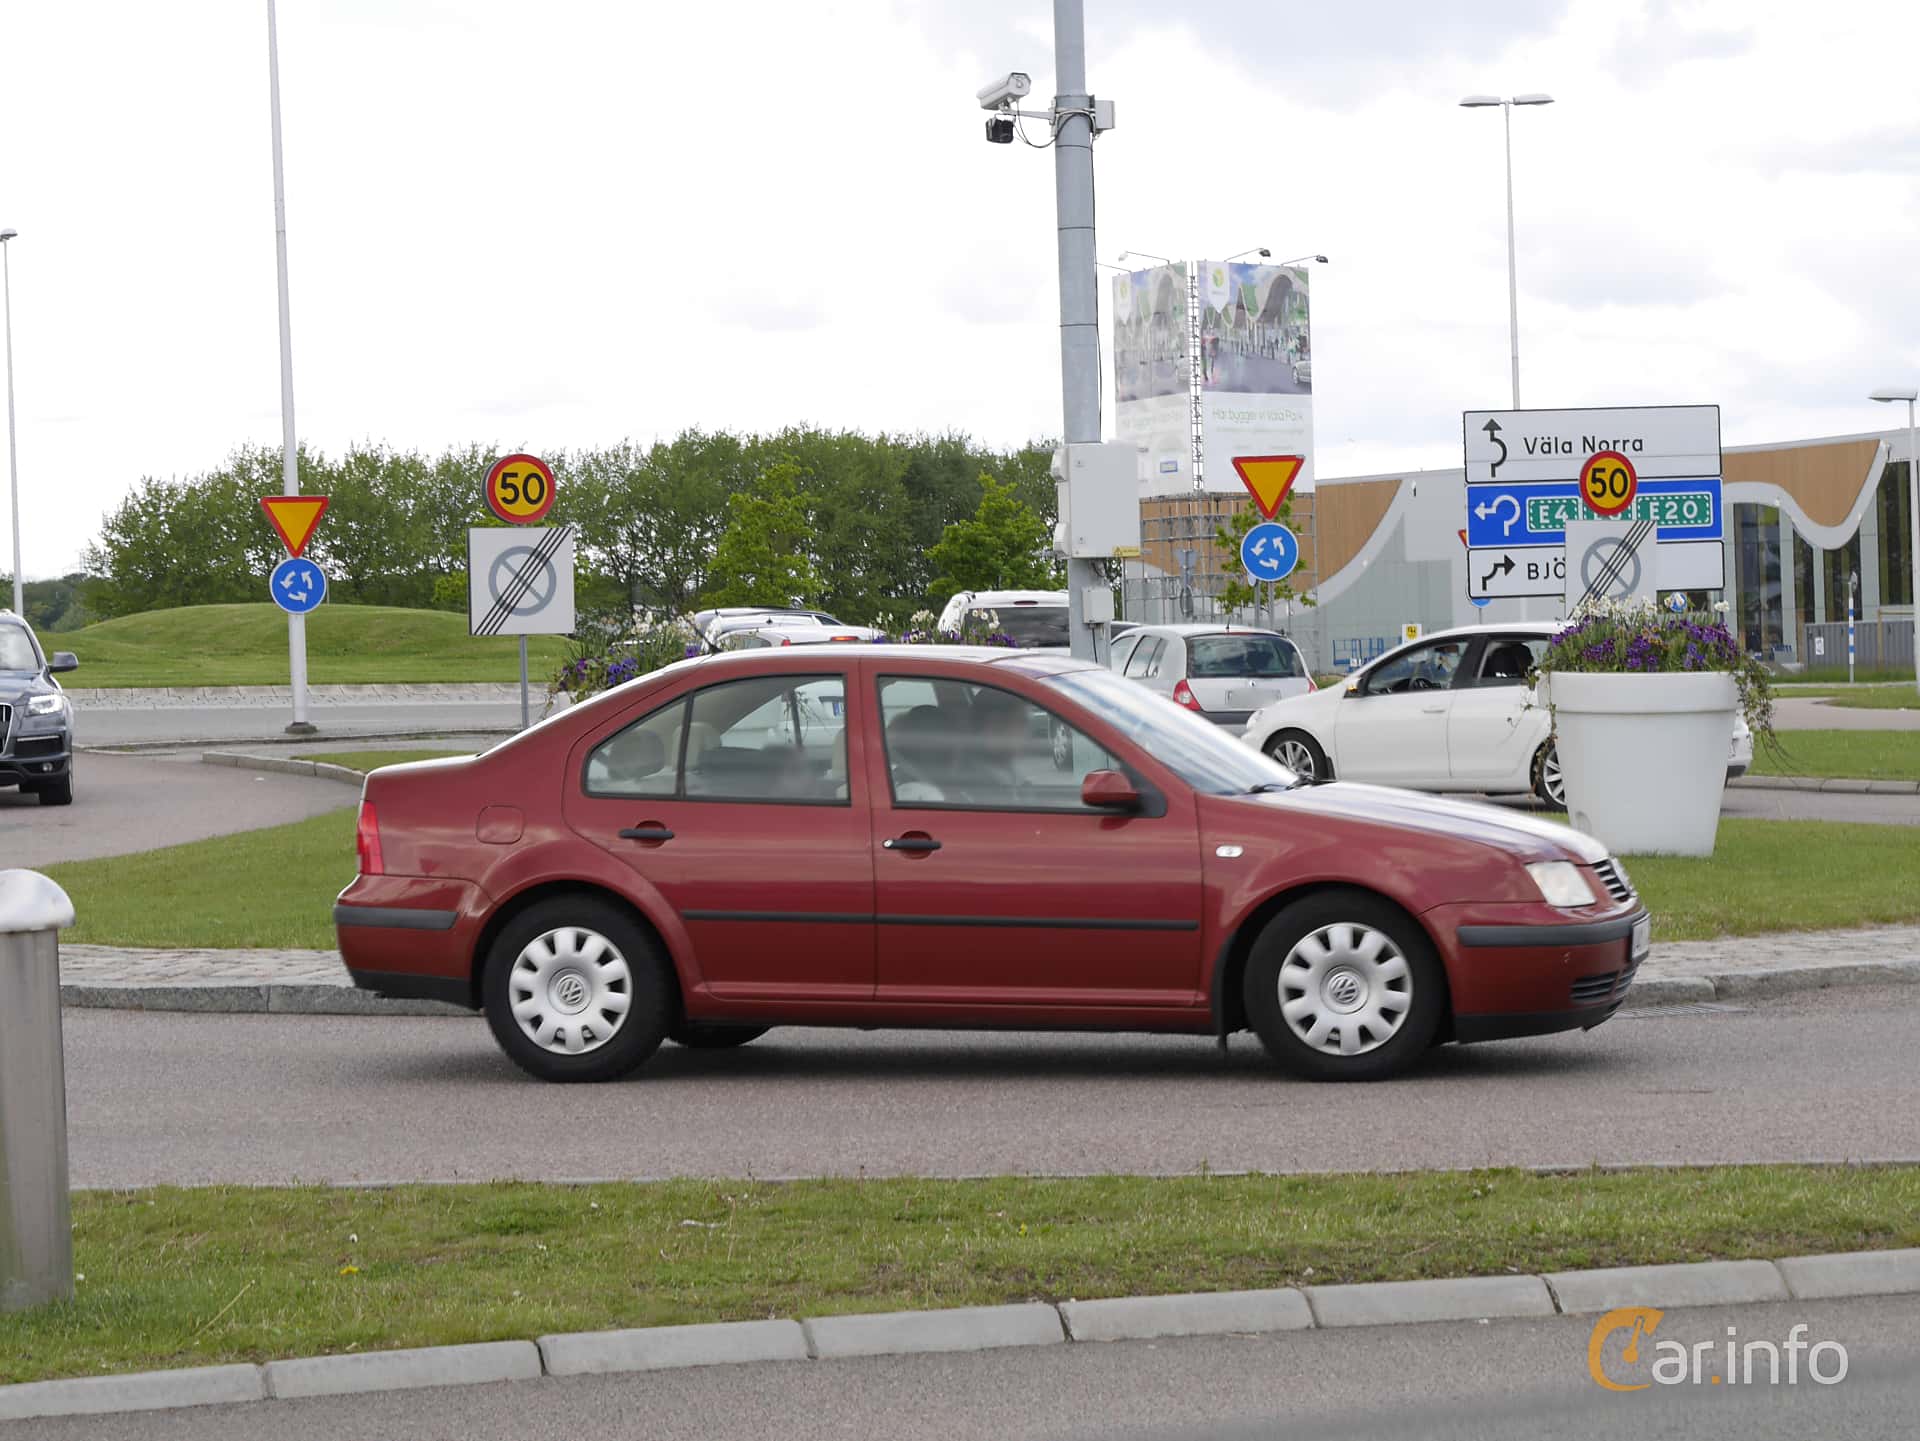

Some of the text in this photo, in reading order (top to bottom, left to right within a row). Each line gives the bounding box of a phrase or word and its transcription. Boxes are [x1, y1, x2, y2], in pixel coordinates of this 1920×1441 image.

[1523, 435, 1643, 455] Väla Norra
[501, 471, 545, 505] 50
[1591, 467, 1629, 498] 50
[1540, 500, 1698, 524] E4 E20
